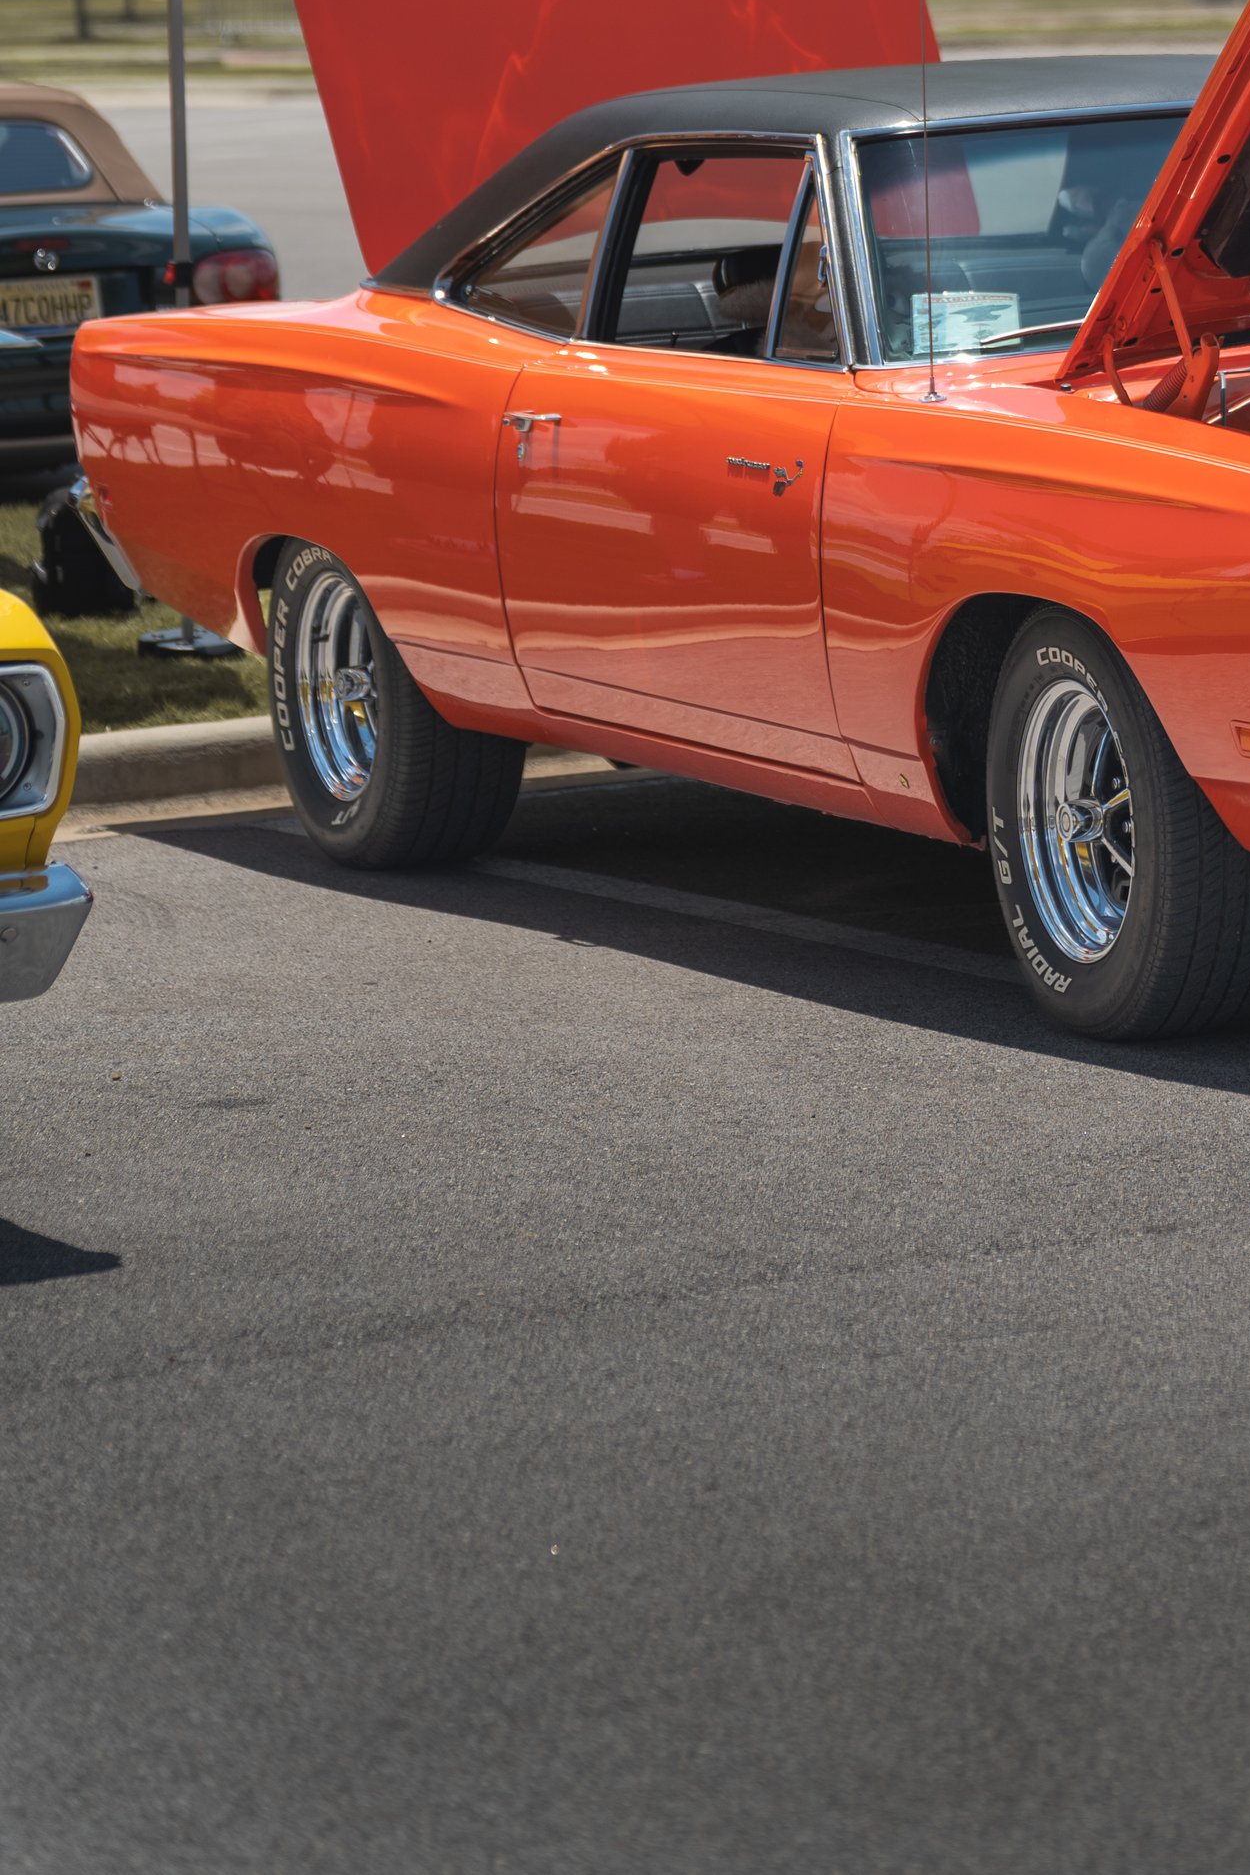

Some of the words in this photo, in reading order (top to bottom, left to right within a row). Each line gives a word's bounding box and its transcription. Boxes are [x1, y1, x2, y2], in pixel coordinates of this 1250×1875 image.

[273, 601, 296, 752] COOPER
[285, 546, 333, 592] COBRA
[1036, 646, 1109, 713] COOPER
[992, 806, 1013, 885] G/T
[1012, 904, 1073, 993] RADIAL
